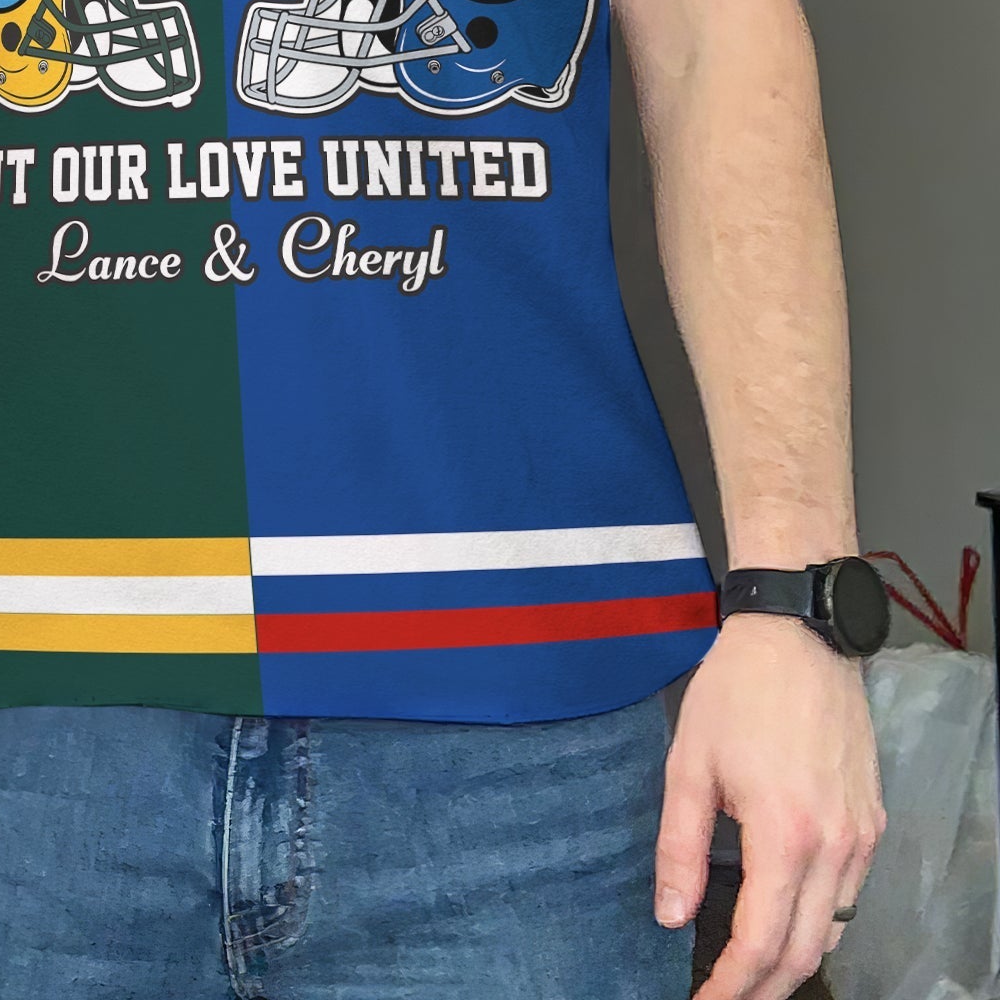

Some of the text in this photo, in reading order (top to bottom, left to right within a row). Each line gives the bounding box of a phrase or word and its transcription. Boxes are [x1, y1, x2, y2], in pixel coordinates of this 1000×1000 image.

[53, 144, 148, 201] OUR
[168, 141, 302, 199] LOVE
[323, 140, 548, 198] UNITED
[37, 216, 444, 292] Lance & Cheryl
